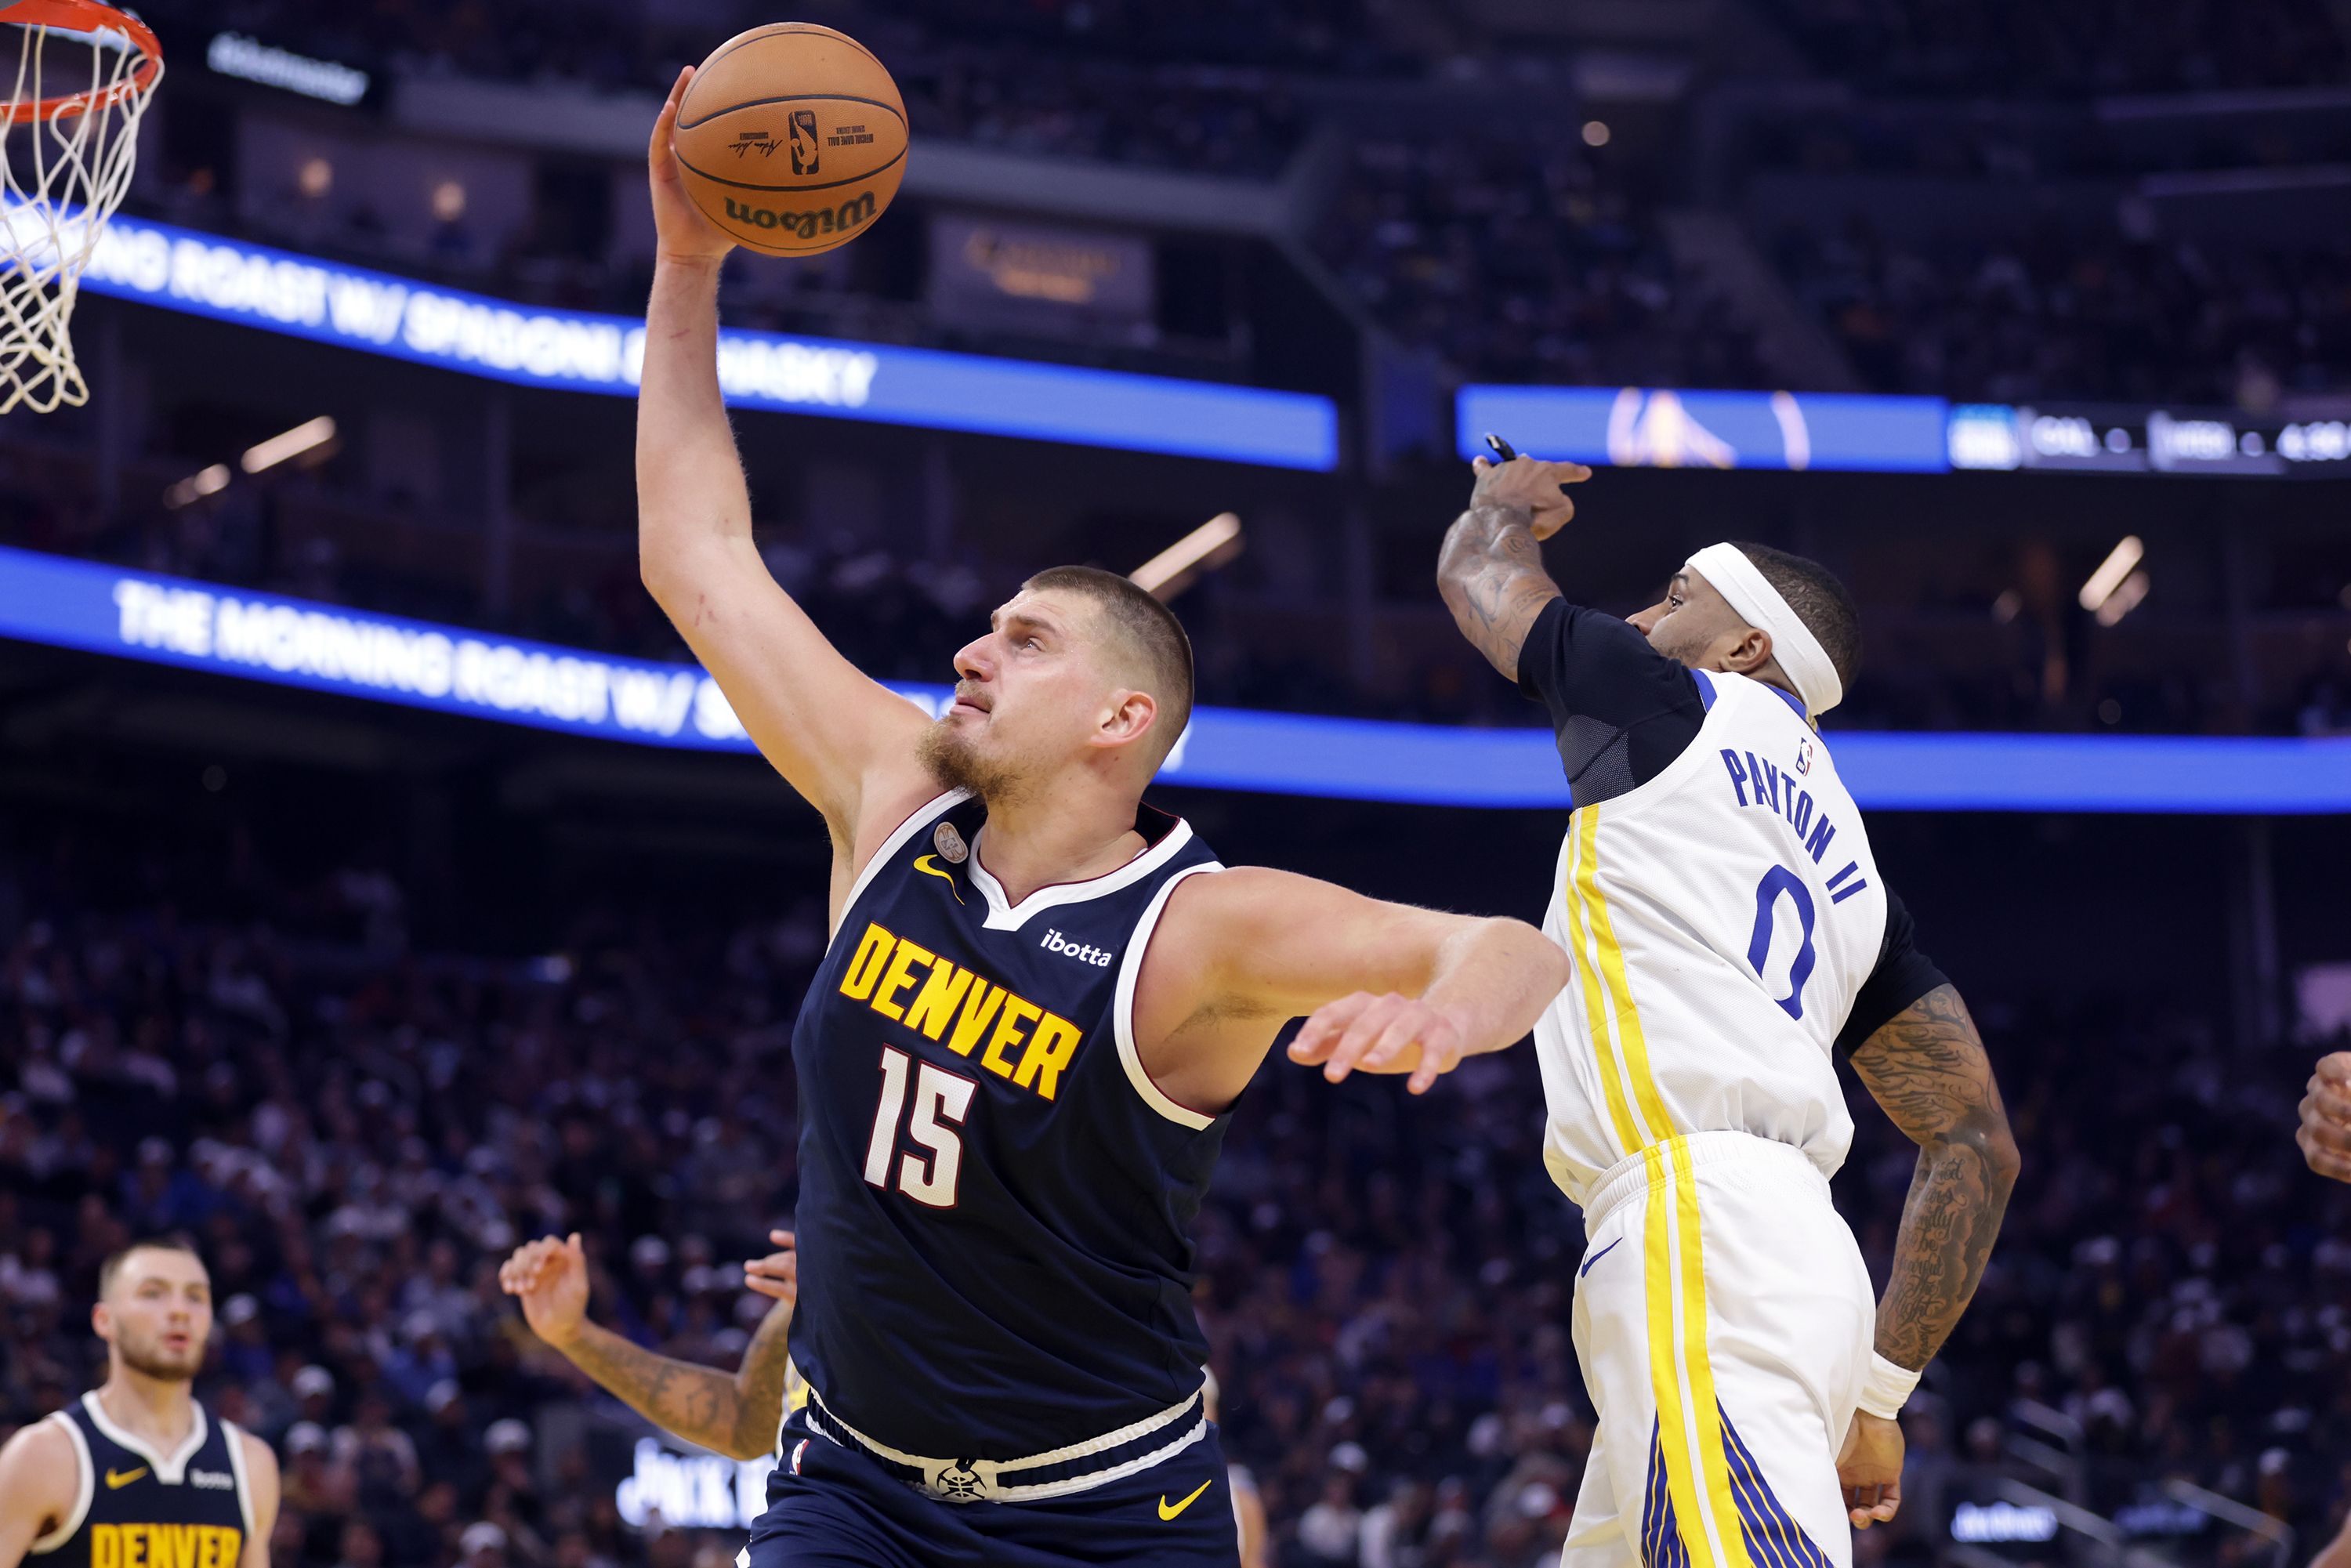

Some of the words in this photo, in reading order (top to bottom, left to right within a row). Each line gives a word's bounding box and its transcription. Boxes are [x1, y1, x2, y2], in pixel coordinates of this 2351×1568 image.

[827, 136, 840, 147] BALL
[840, 135, 855, 146] GAME
[854, 133, 874, 145] OFFICIAL
[723, 190, 877, 240] Wilson
[113, 578, 214, 657] THE
[216, 597, 453, 697] MORNING
[453, 639, 608, 724] ROAST
[1719, 748, 1836, 865] PAYTON
[1825, 860, 1867, 905] II
[1039, 928, 1112, 969] ibotta
[1747, 864, 1816, 1021] 0
[839, 920, 1085, 1103] DENVER
[863, 1042, 980, 1210] 15
